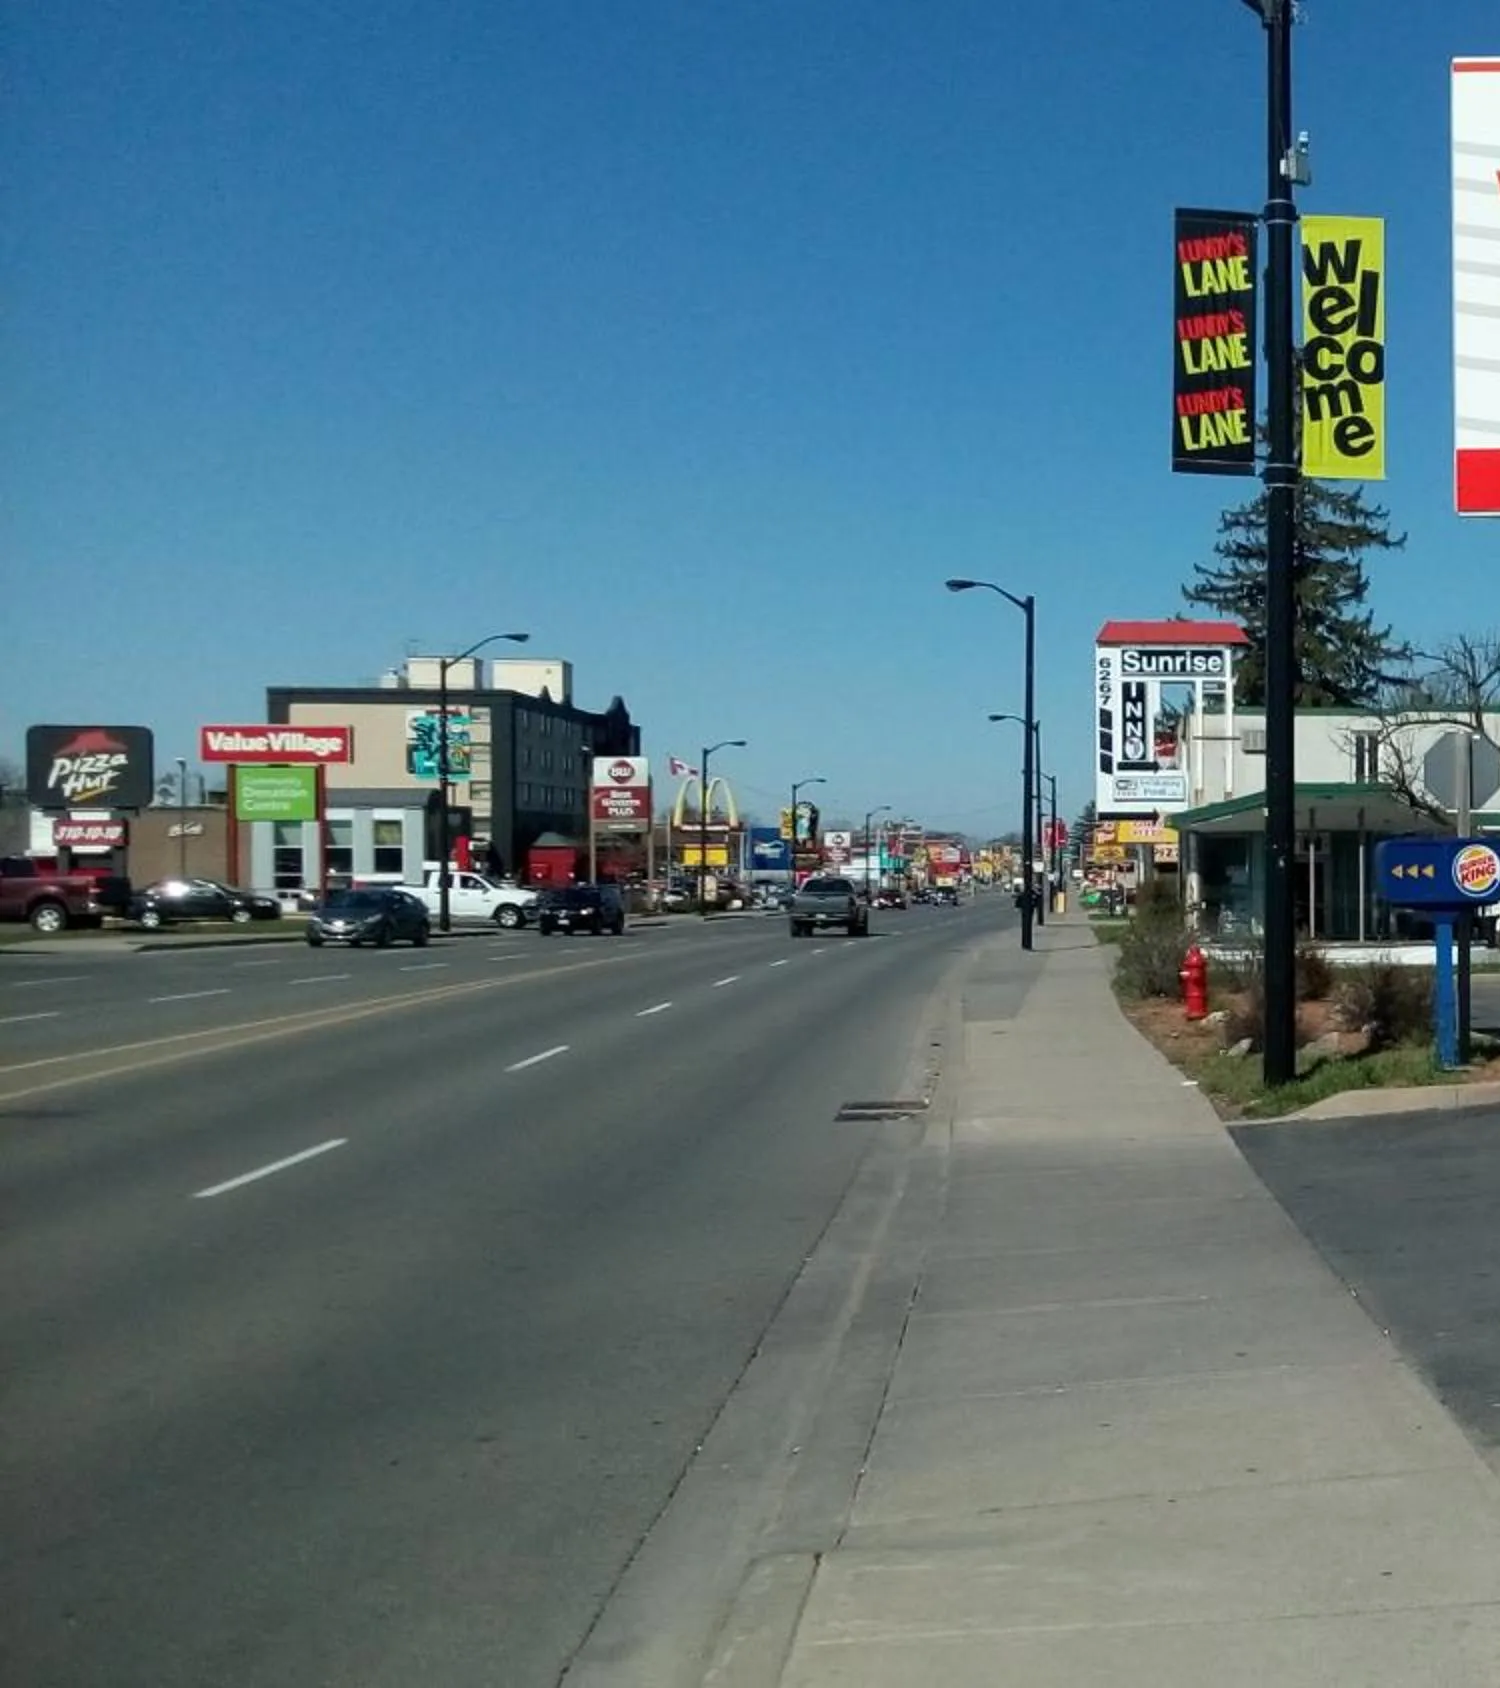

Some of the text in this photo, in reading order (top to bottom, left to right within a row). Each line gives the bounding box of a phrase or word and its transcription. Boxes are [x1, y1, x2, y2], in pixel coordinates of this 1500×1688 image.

[1178, 233, 1246, 262] LUNDY'S
[1182, 256, 1253, 297] LANE
[1177, 311, 1245, 340] LUNDY'S
[1181, 334, 1252, 375] LANE
[1302, 239, 1385, 457] welcome
[1177, 388, 1244, 417] LUNDY'S
[1180, 411, 1251, 452] LANE
[1123, 650, 1222, 672] Sunrise
[1124, 681, 1143, 738] INN
[205, 731, 344, 757] Value Village
[47, 751, 128, 789] Pizza
[61, 769, 121, 798] Hut
[1461, 864, 1497, 883] KING
